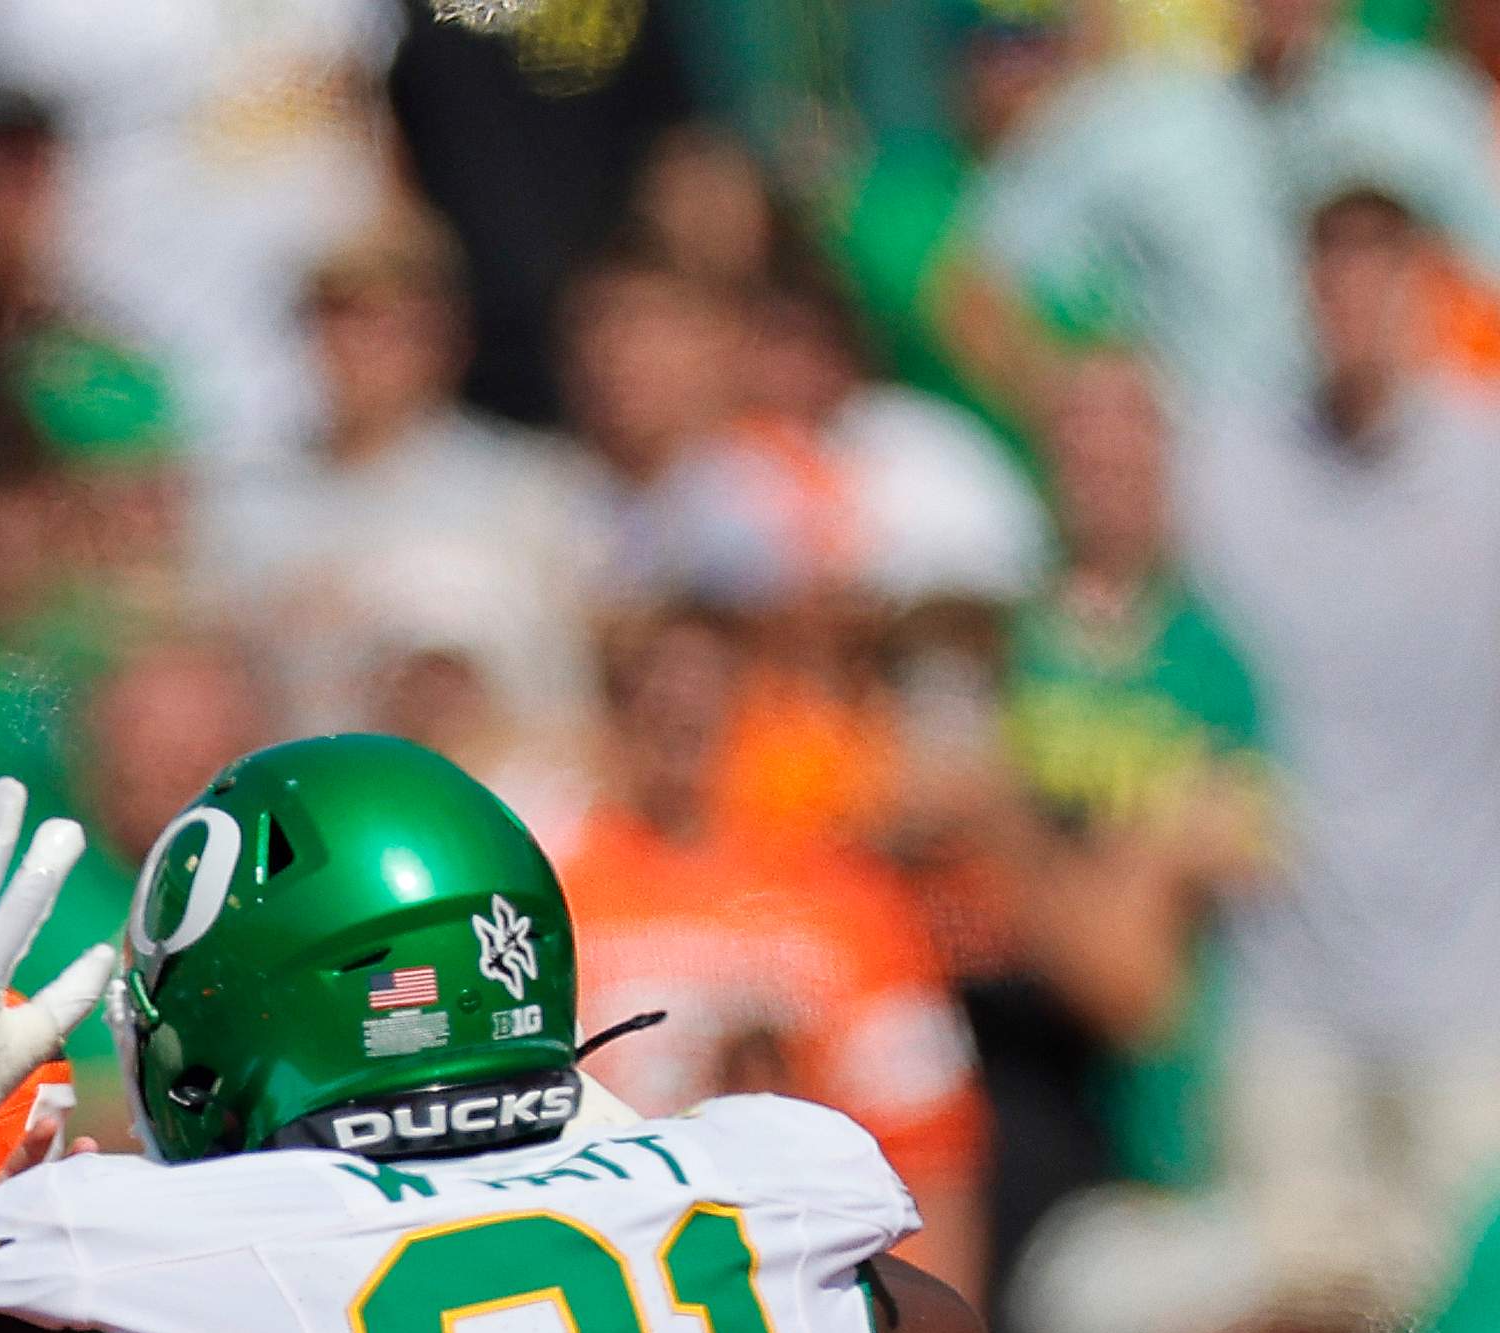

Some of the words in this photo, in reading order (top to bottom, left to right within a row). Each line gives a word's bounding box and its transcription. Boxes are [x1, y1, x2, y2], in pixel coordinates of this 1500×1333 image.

[130, 805, 241, 956] O
[331, 1086, 575, 1149] DUCKS
[331, 1133, 692, 1203] WTT
